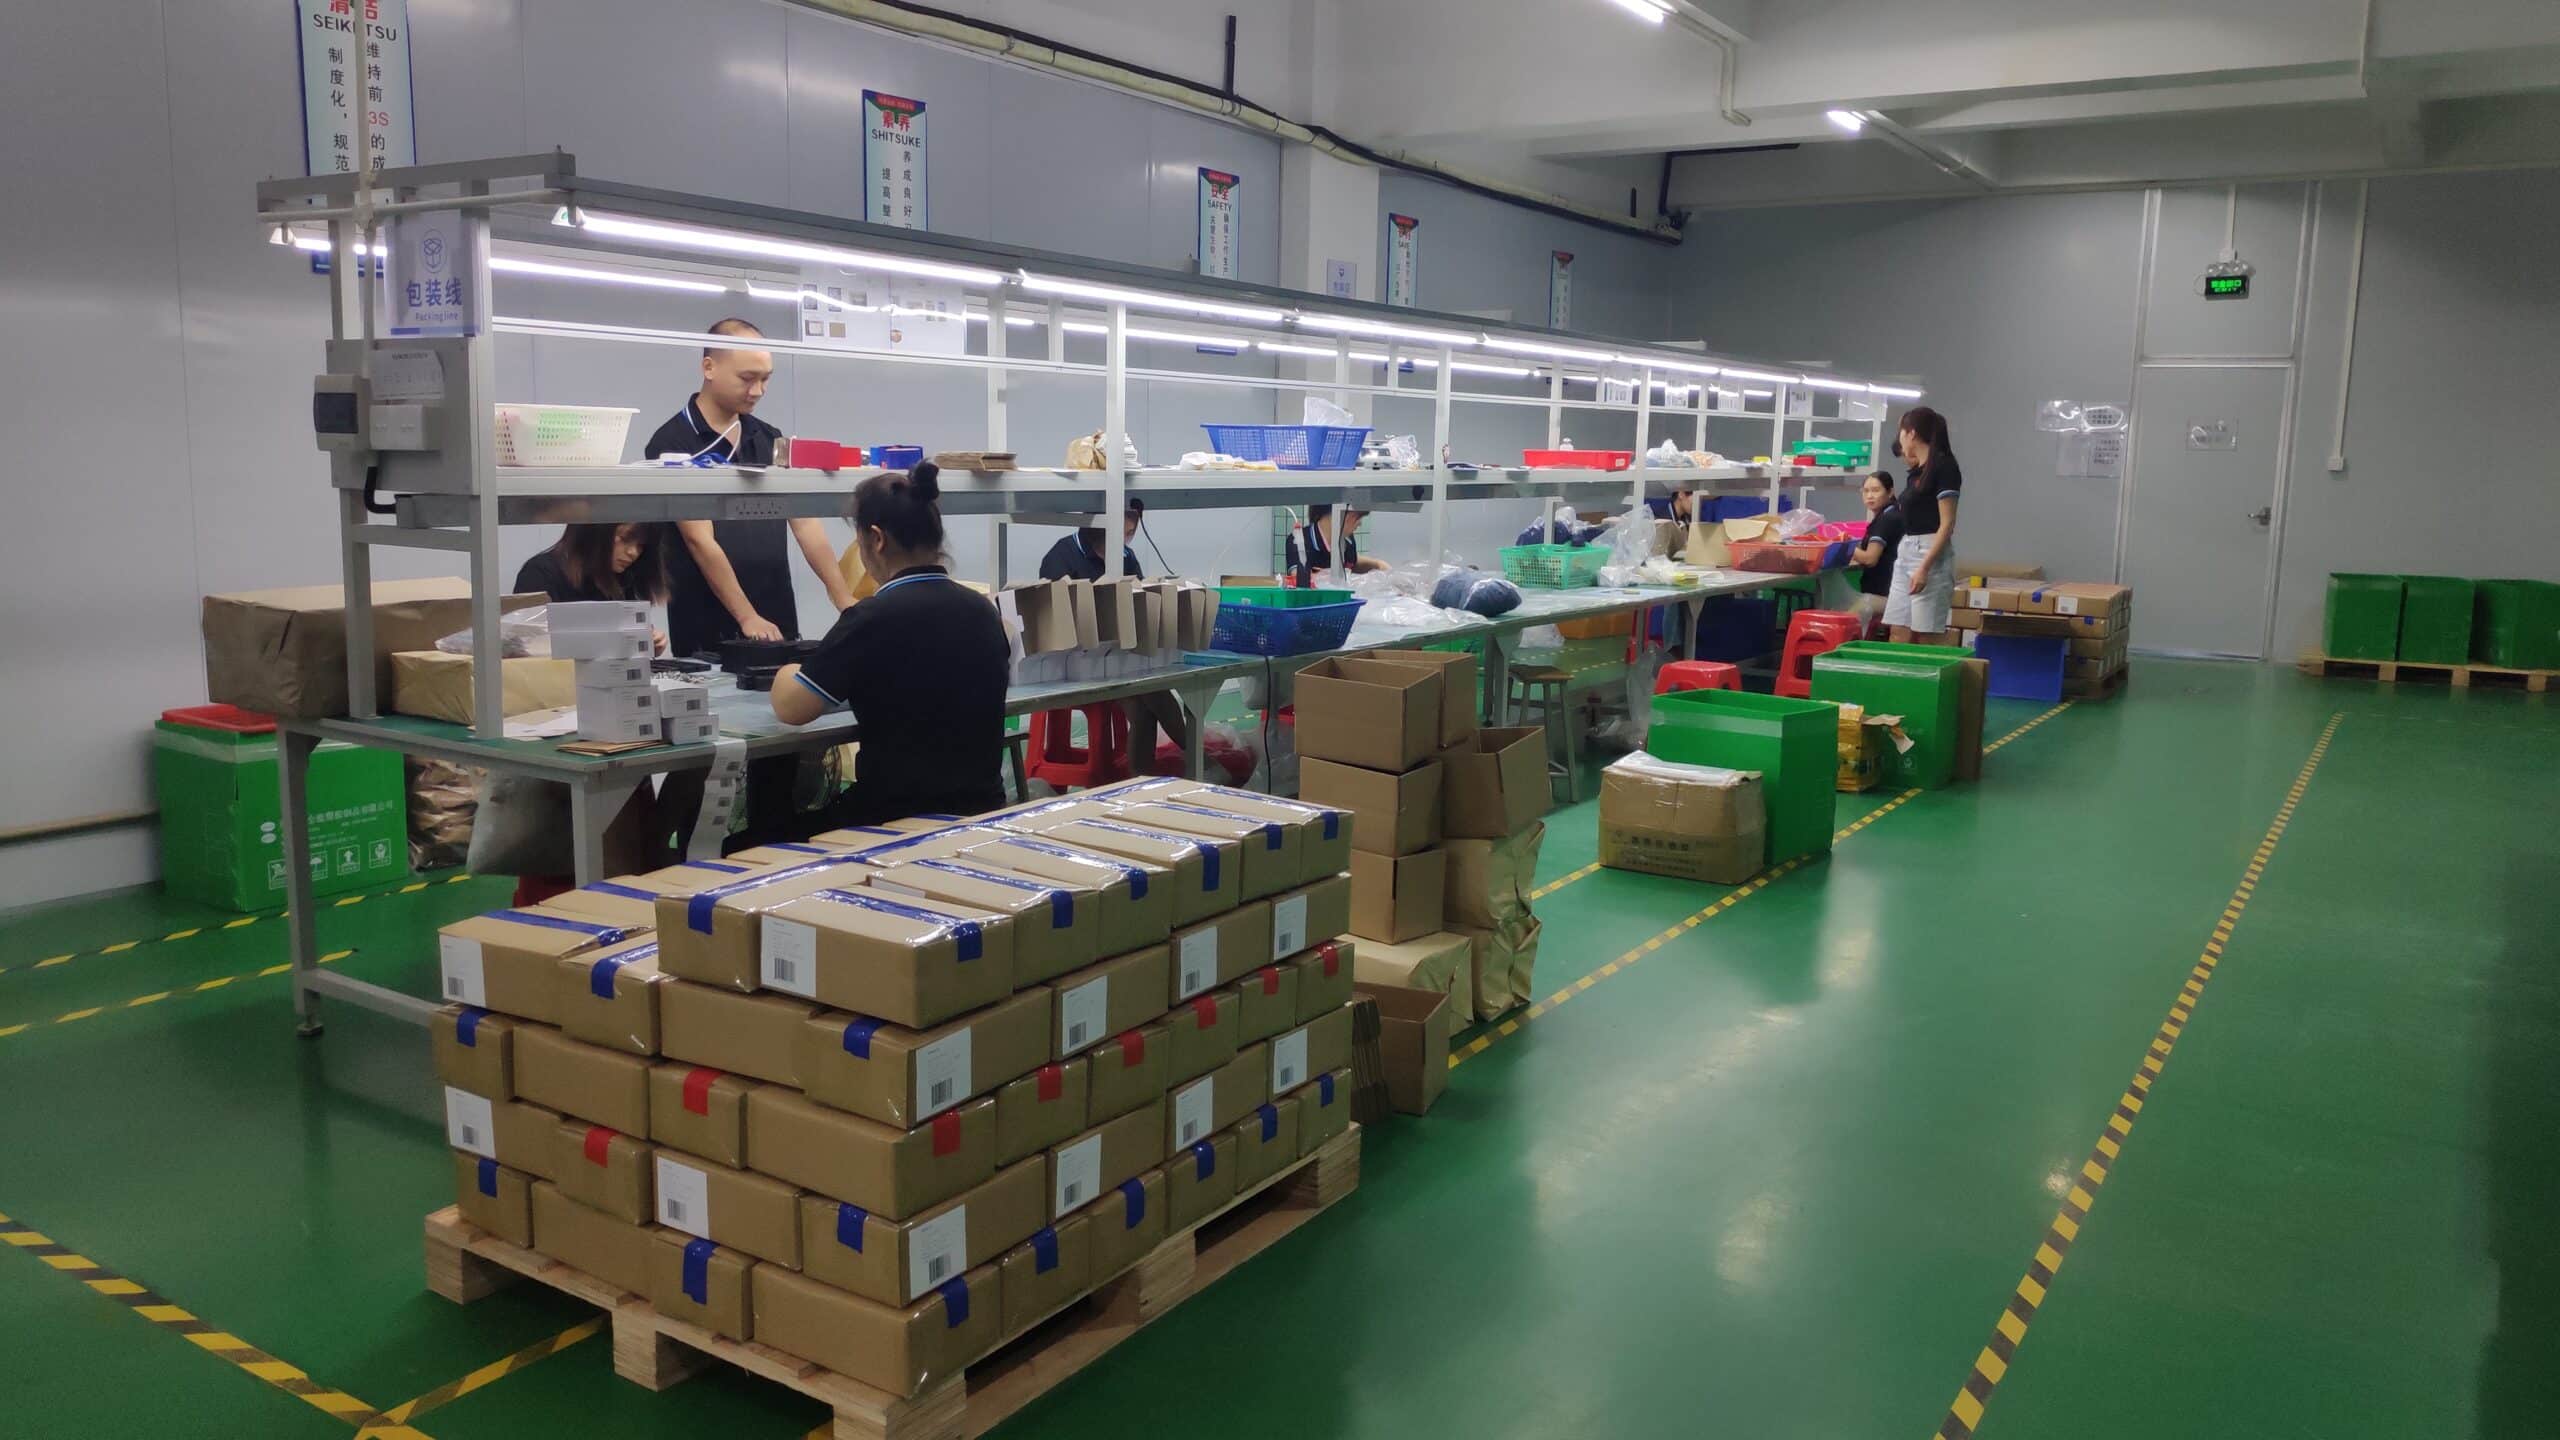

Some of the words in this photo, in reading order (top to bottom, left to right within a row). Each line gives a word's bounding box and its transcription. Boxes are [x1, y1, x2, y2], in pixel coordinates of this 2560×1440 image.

[313, 14, 397, 41] SEIKTSU
[871, 128, 921, 148] SHITSUKE
[1207, 199, 1232, 212] SAFETY
[406, 277, 463, 308] 包装线
